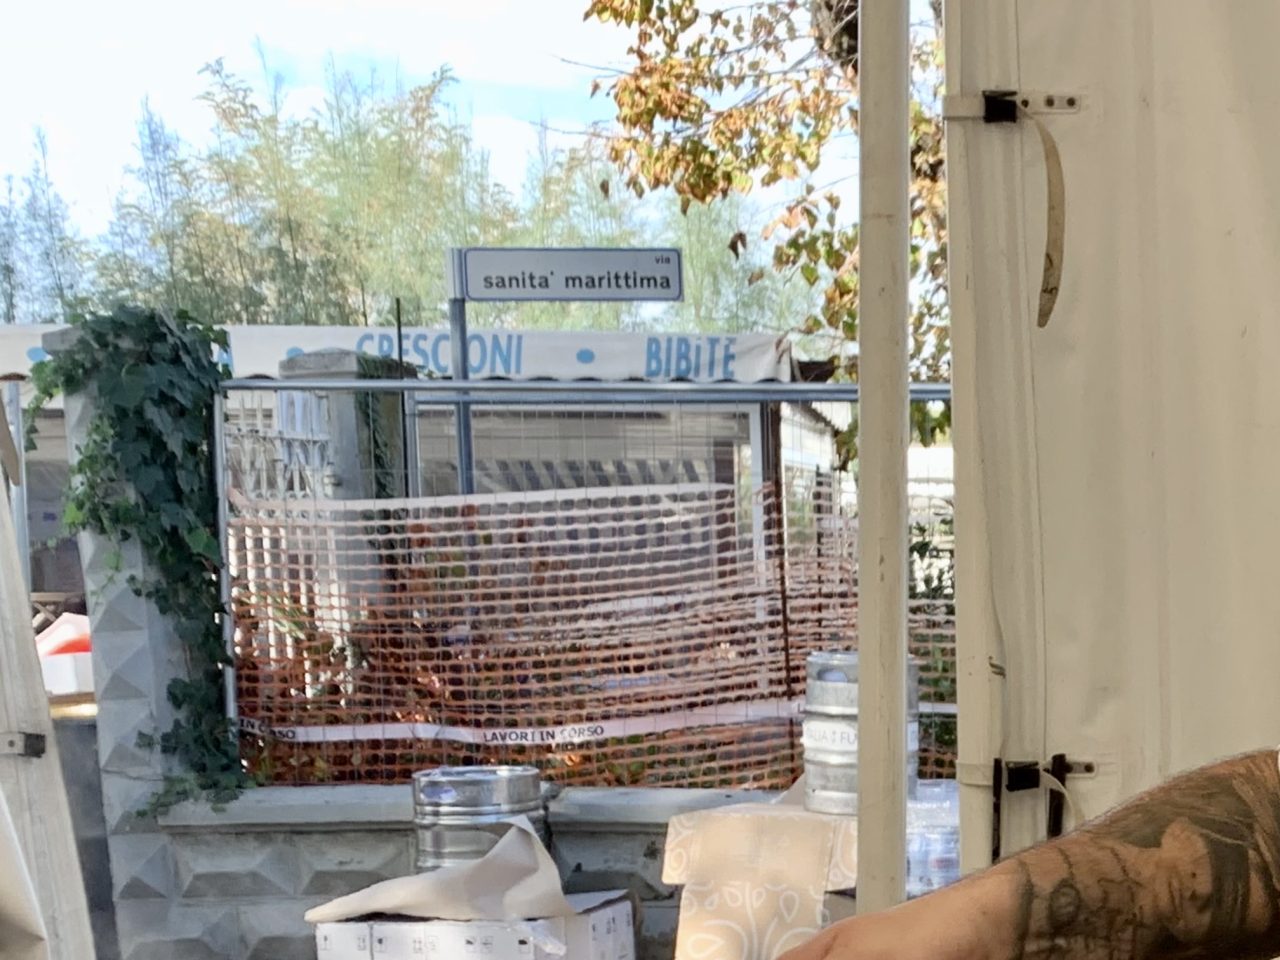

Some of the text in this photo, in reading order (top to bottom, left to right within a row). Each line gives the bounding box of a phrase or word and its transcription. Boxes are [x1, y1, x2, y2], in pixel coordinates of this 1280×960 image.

[655, 255, 671, 265] via
[483, 270, 671, 290] sanita' marittima
[356, 332, 524, 375] CRSCONI
[483, 725, 605, 743] LAVORI IN CORSO
